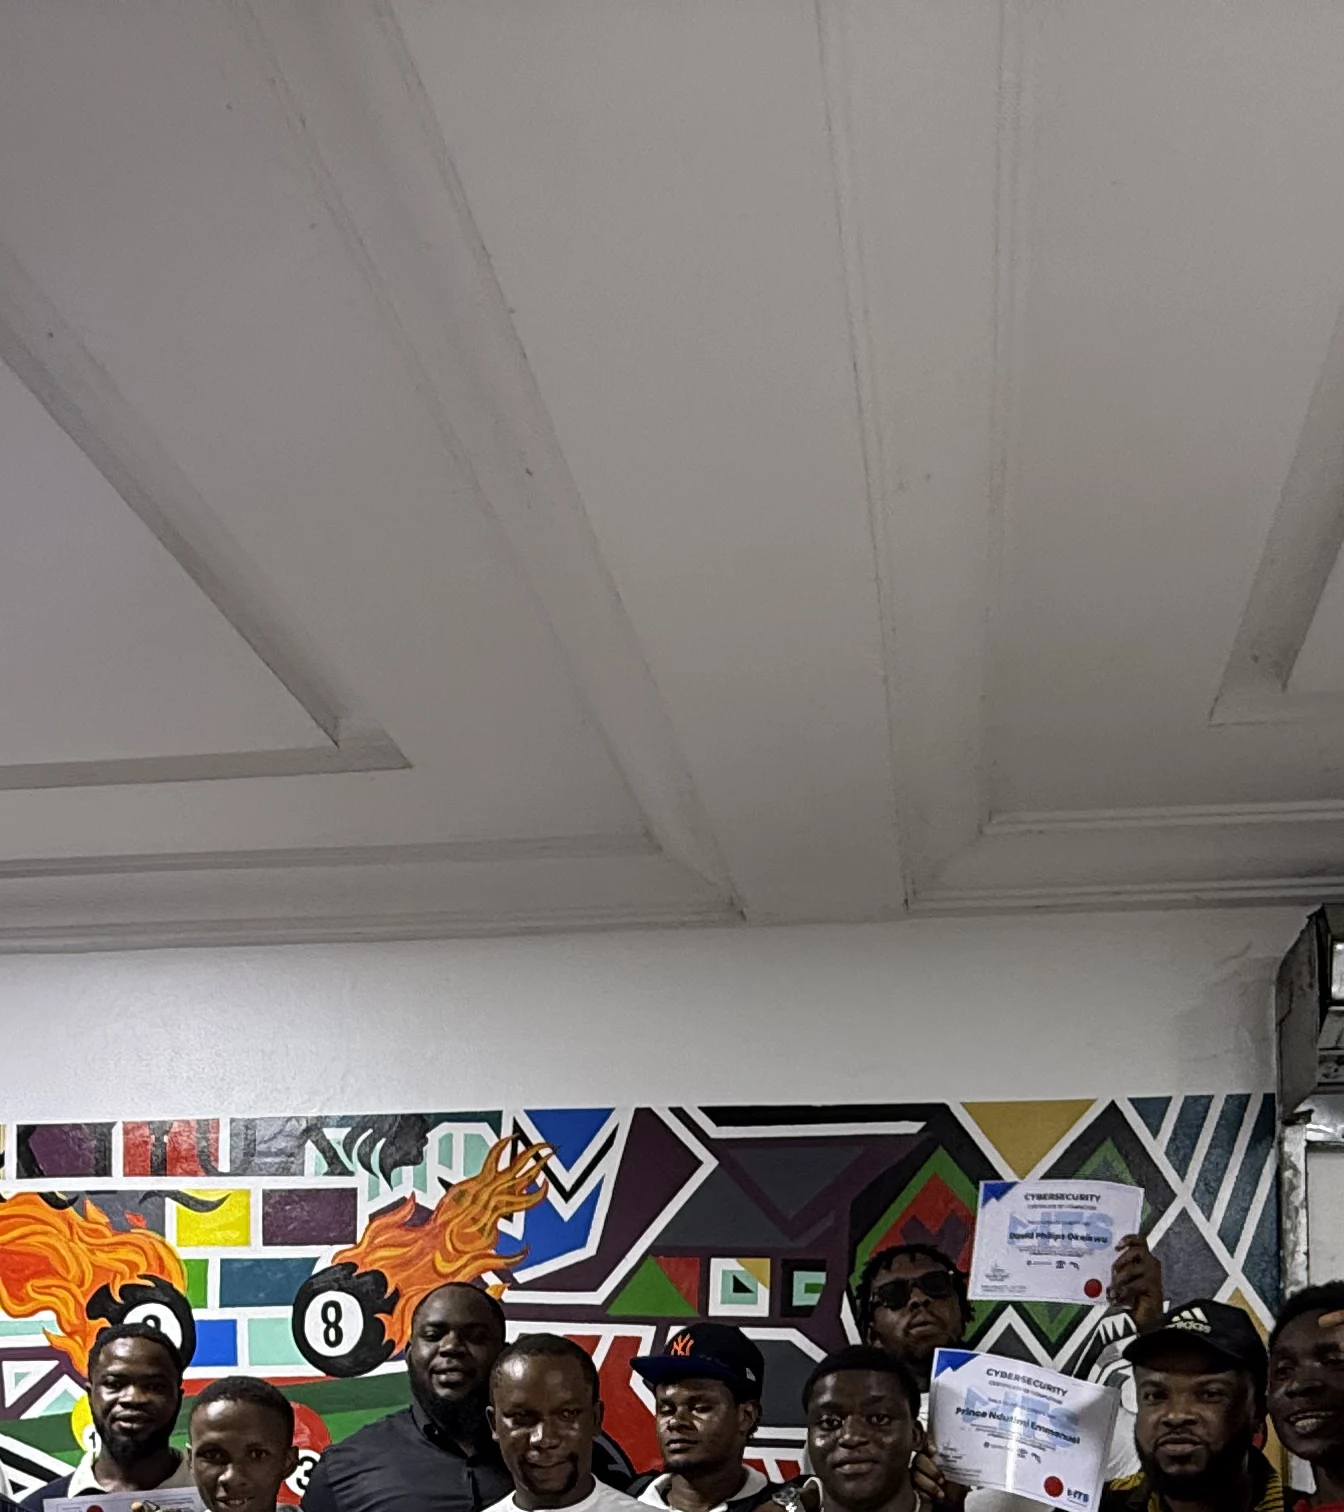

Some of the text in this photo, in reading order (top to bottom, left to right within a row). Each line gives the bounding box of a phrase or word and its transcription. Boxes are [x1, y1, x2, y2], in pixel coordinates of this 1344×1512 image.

[1024, 1192, 1101, 1202] CYBERSECURITY
[321, 1300, 343, 1349] 8
[986, 1368, 1068, 1396] CYBERSECURITY
[955, 1407, 988, 1418] Prince
[1031, 1421, 1080, 1444] Emmanuel
